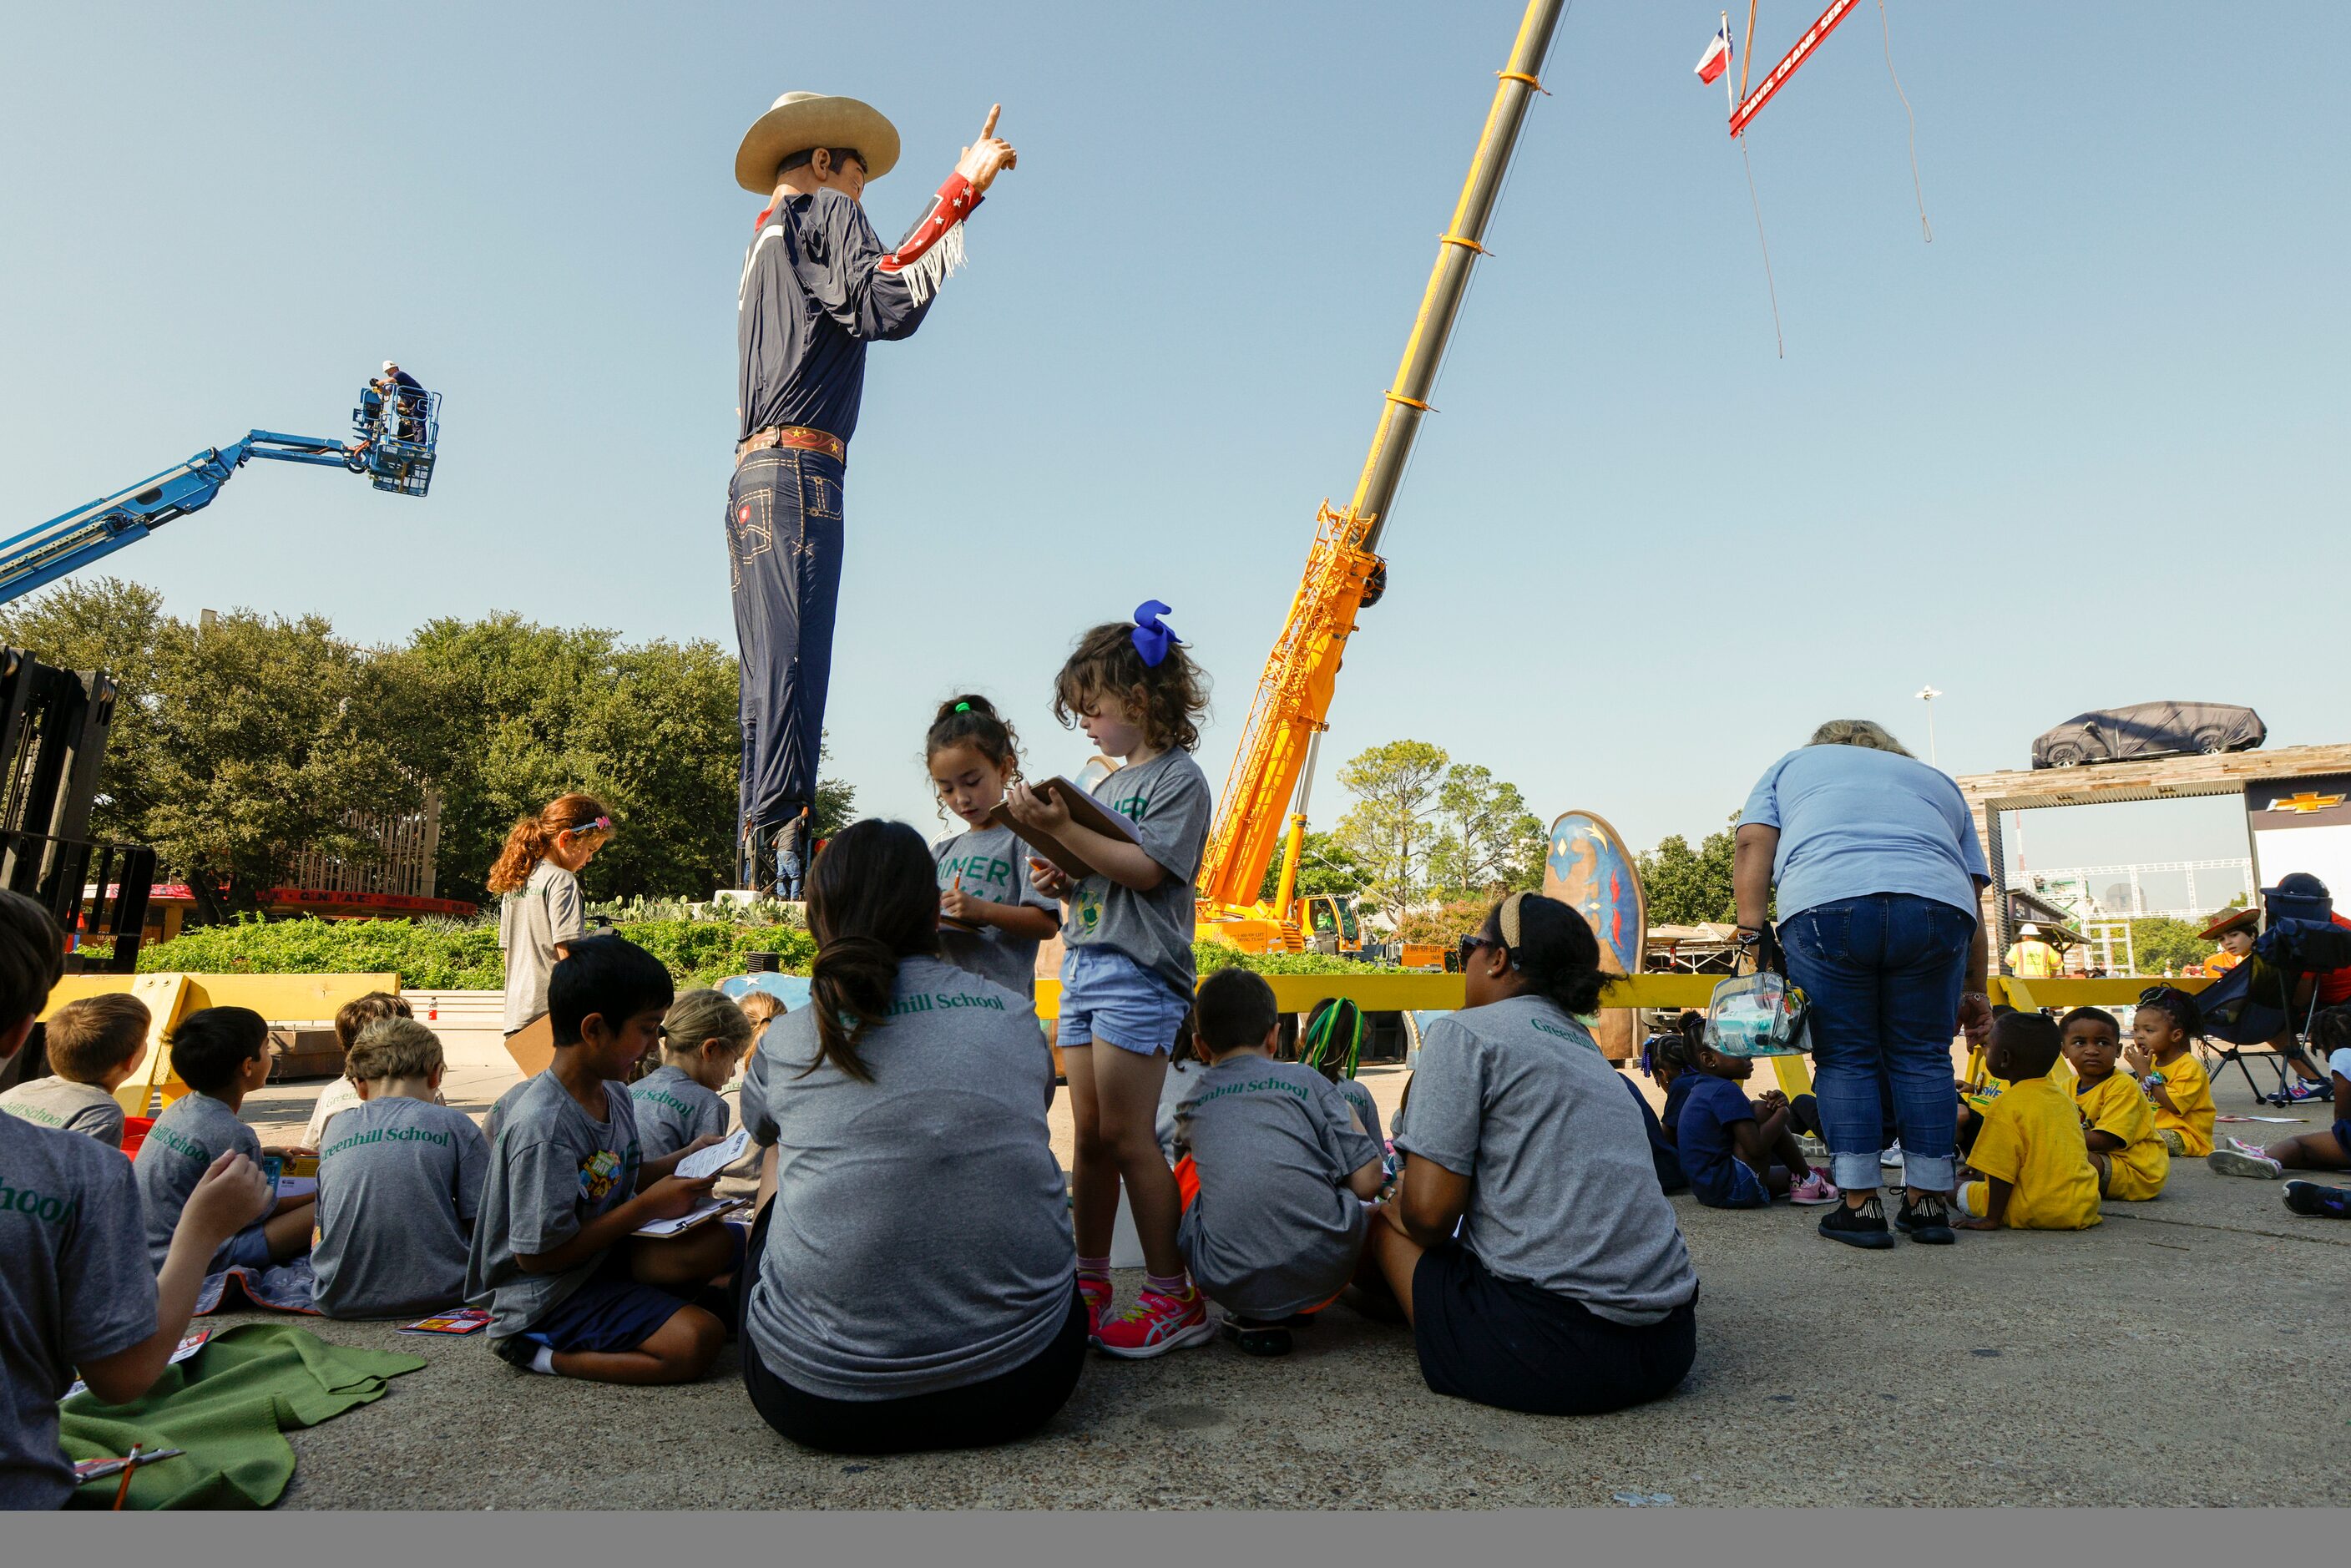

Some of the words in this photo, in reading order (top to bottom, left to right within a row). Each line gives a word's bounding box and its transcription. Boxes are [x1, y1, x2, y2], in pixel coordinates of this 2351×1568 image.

[1742, 78, 1773, 119] DAVIS
[1777, 28, 1816, 79] CRANE
[935, 993, 1006, 1011] School
[1531, 1018, 1597, 1052] Greenhill
[1247, 1077, 1309, 1101] School
[644, 1090, 695, 1118] School
[386, 1126, 449, 1146] School
